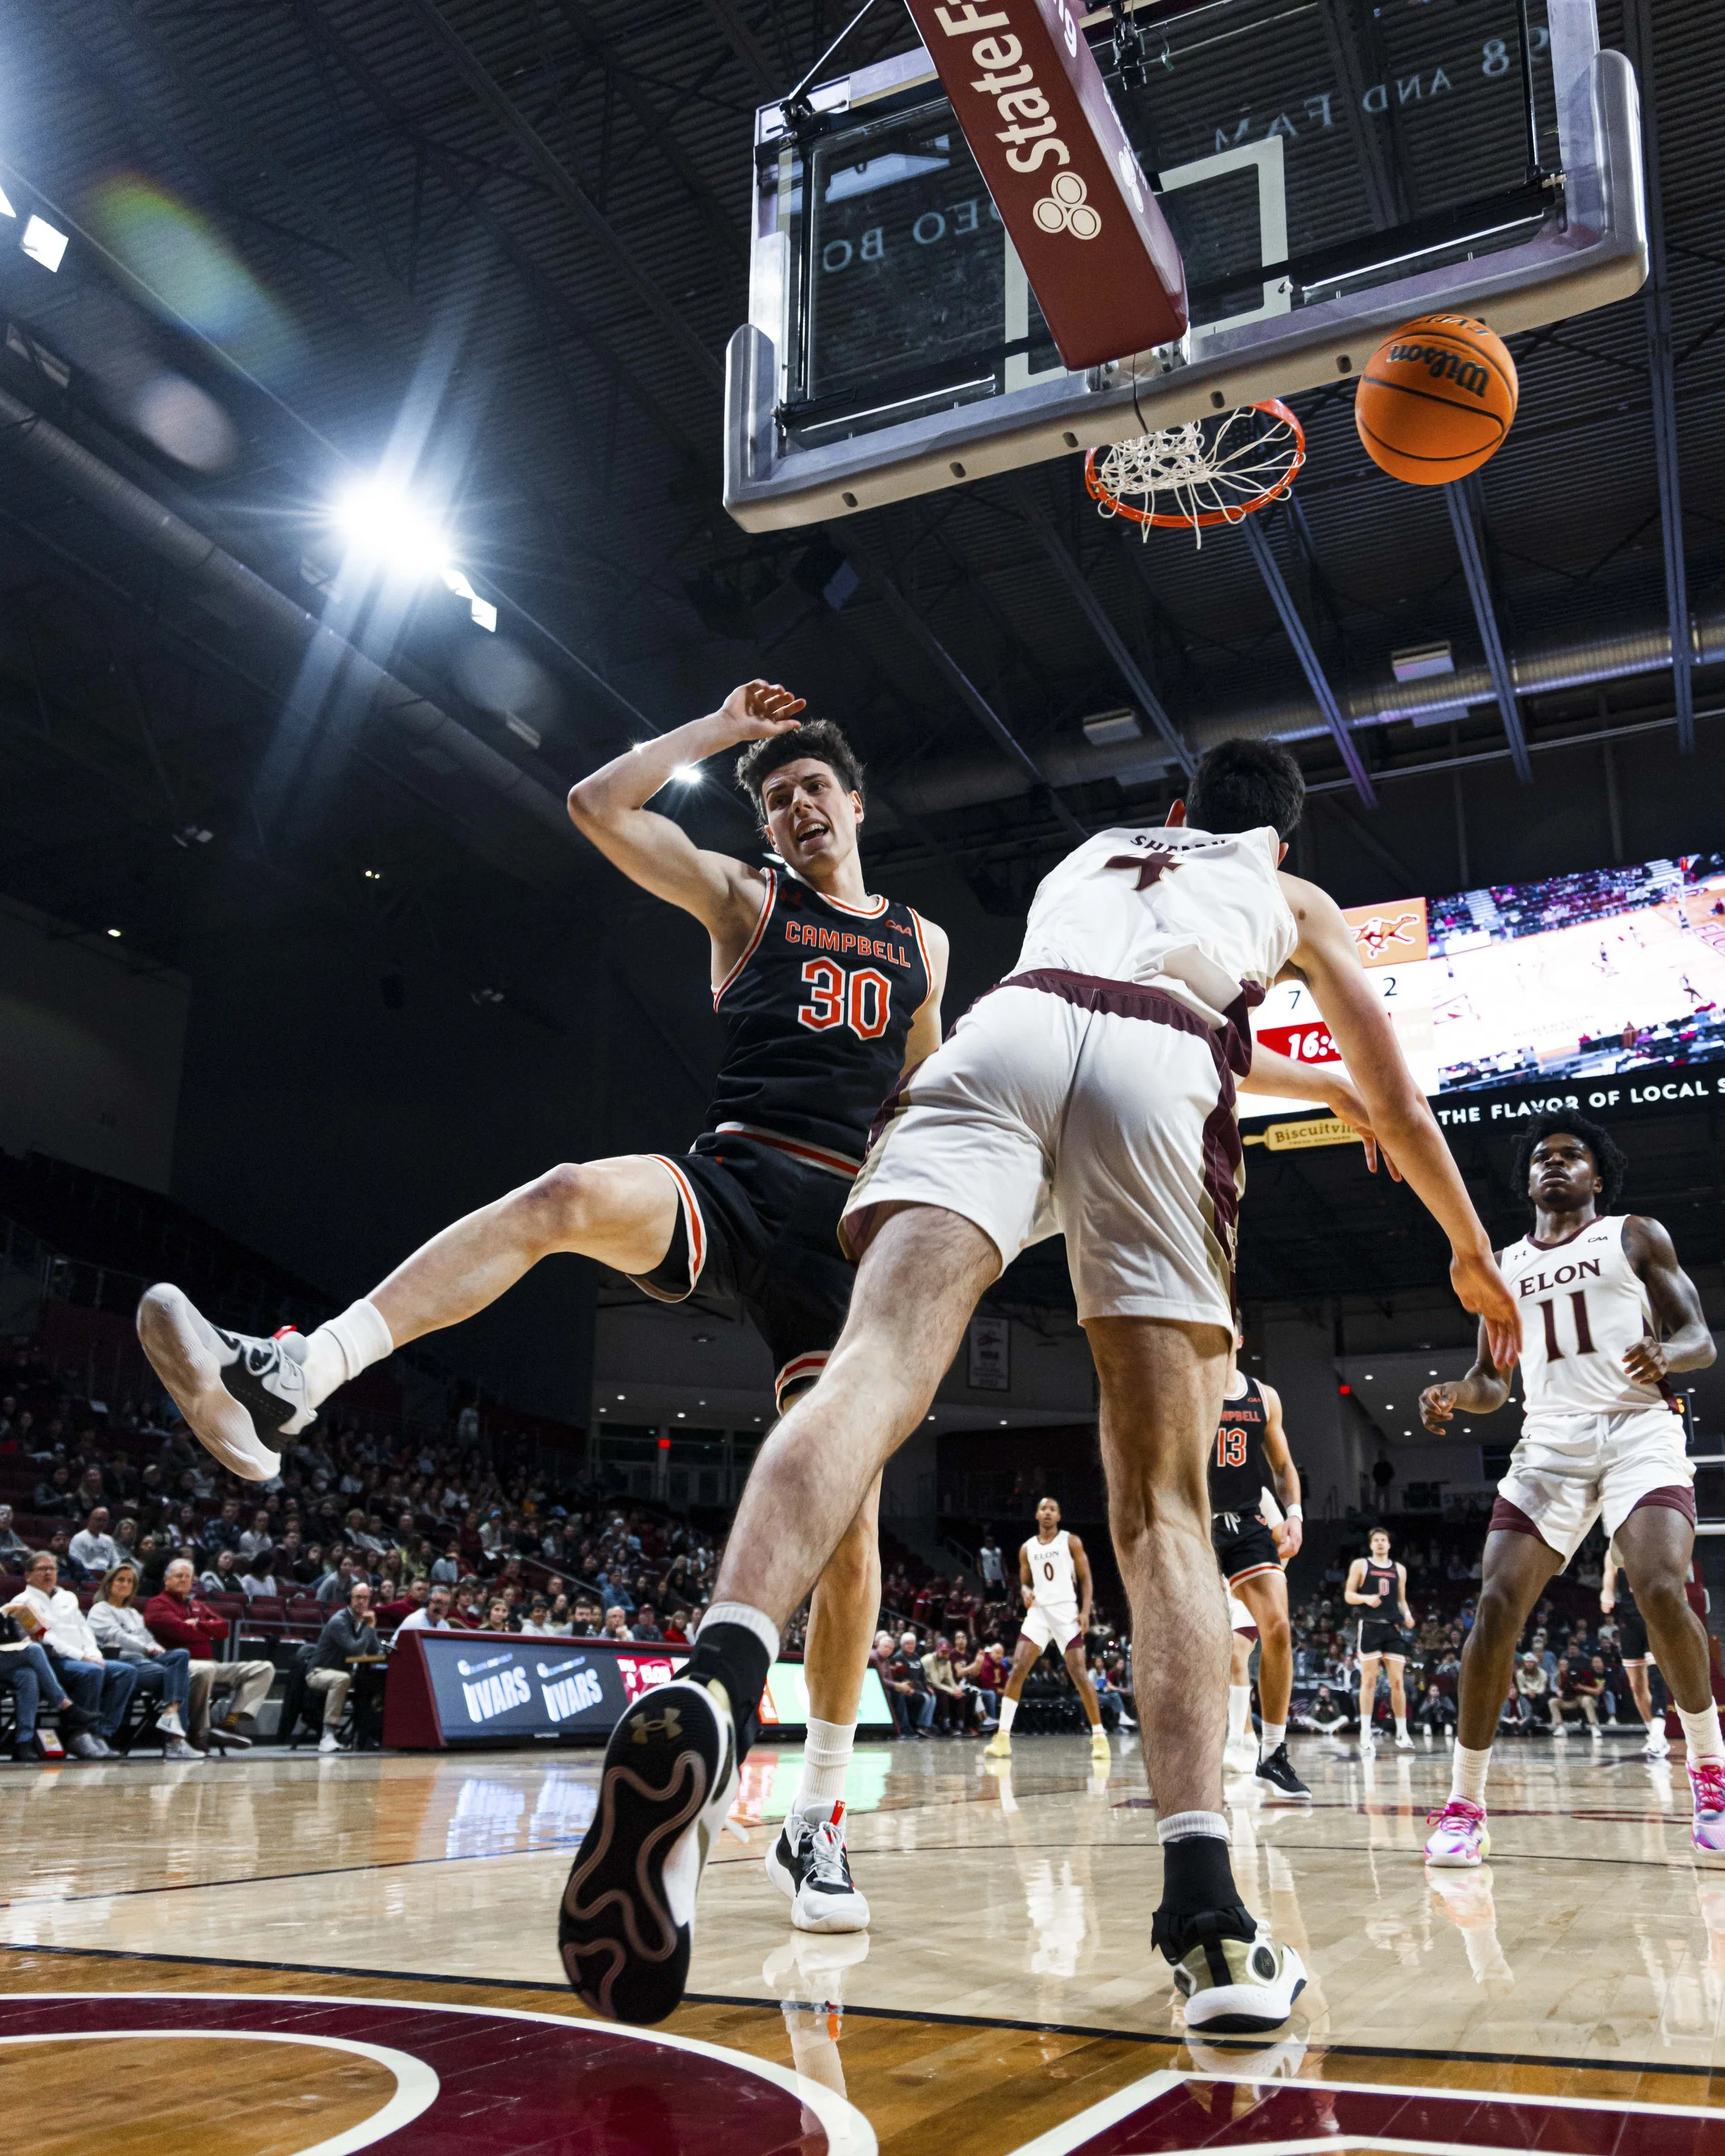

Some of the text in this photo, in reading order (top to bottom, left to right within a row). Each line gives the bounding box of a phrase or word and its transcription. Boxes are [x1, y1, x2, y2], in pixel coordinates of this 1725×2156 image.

[934, 0, 1070, 172] StateF
[1386, 344, 1488, 398] Wilson
[785, 920, 911, 968] CAMPBELL
[885, 919, 913, 937] CAA
[798, 956, 891, 1040] 30
[1288, 990, 1301, 1010] 7
[1383, 977, 1398, 997] 2
[1437, 1106, 1481, 1125] THE
[1491, 1096, 1579, 1119] FLAVOR
[1588, 1090, 1620, 1108] OF
[1630, 1080, 1709, 1104] LOCAL
[1519, 1258, 1601, 1298] ELON
[1535, 1289, 1599, 1363] 11
[1216, 1427, 1247, 1467] 13
[1034, 1551, 1060, 1561] ELON
[1044, 1562, 1054, 1581] 0
